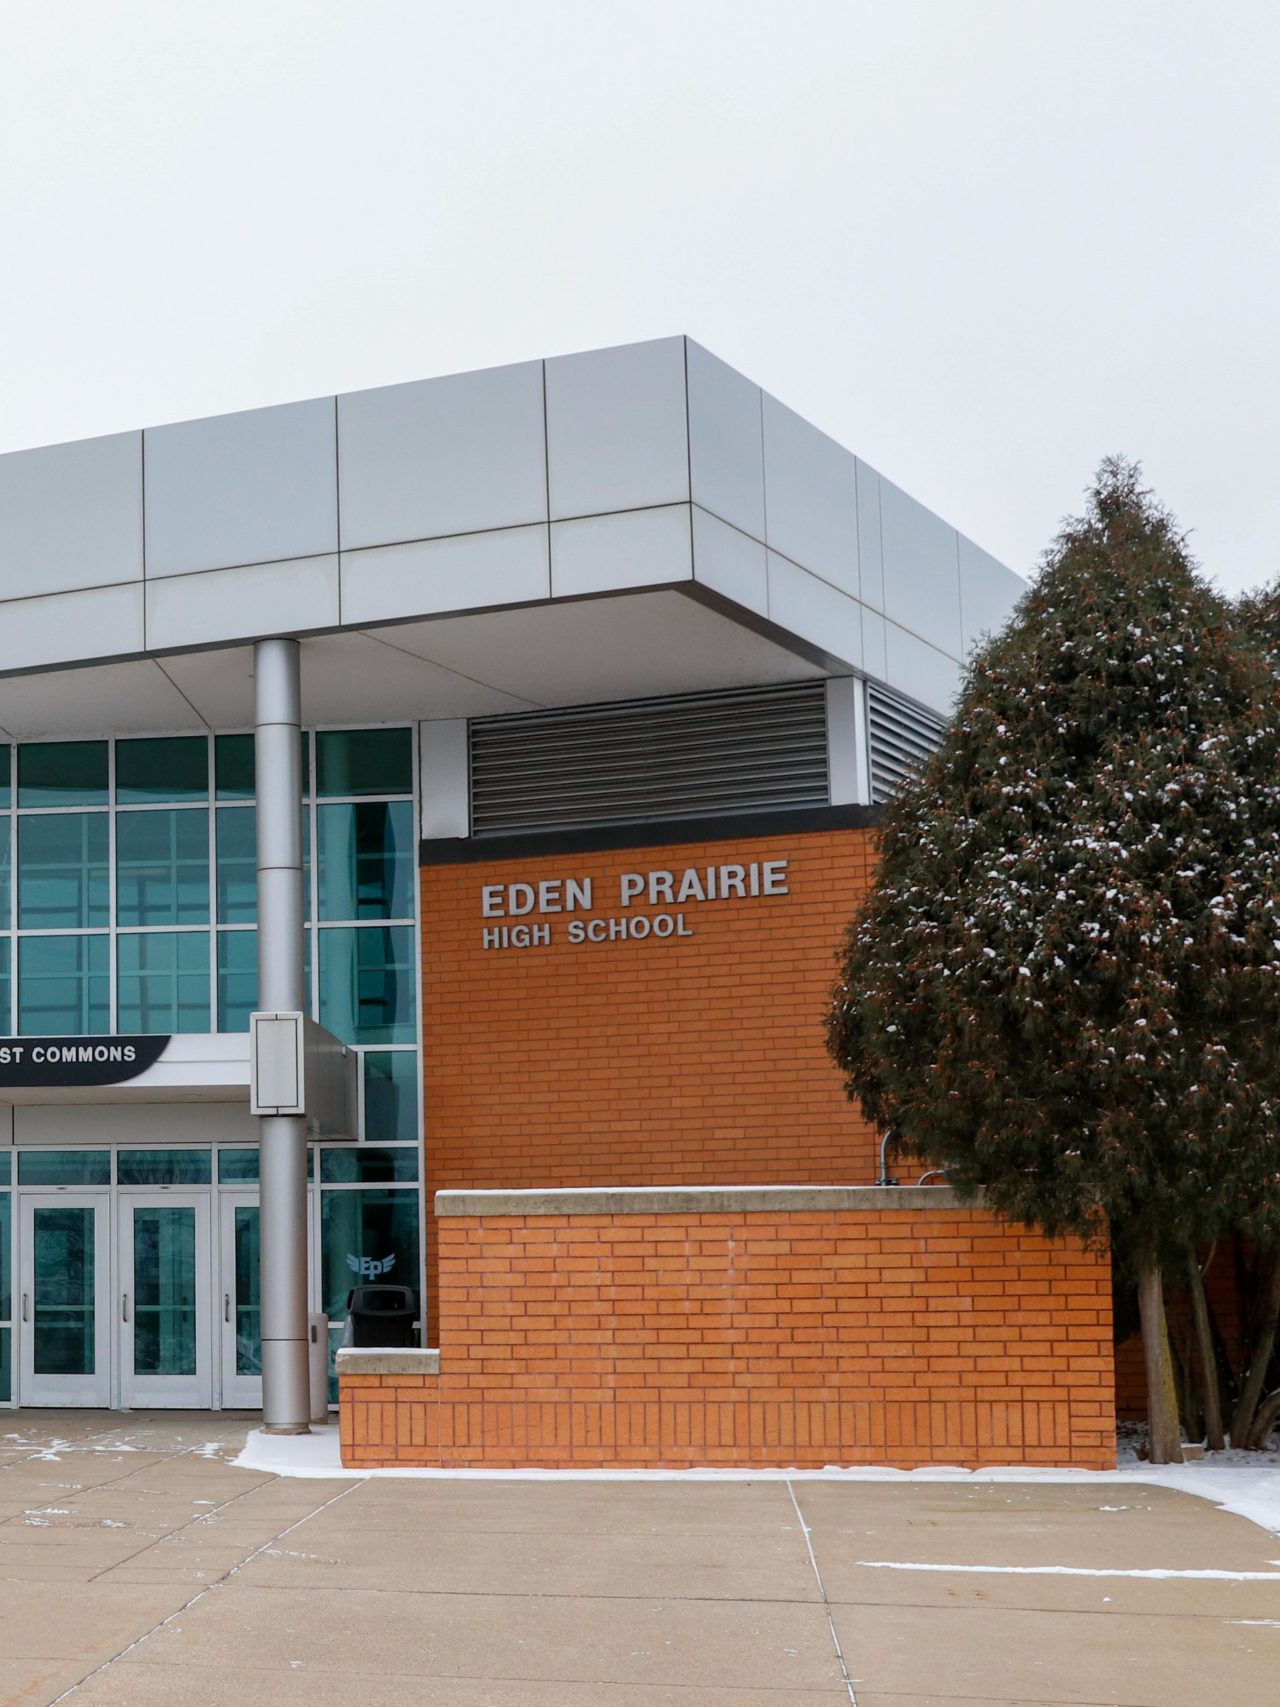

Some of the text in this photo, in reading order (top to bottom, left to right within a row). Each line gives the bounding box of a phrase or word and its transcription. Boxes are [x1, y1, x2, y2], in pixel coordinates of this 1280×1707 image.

[482, 860, 789, 918] EDEN PRAIRIE
[483, 913, 694, 949] HIGH SCHOOL
[32, 1045, 136, 1063] COMMONS
